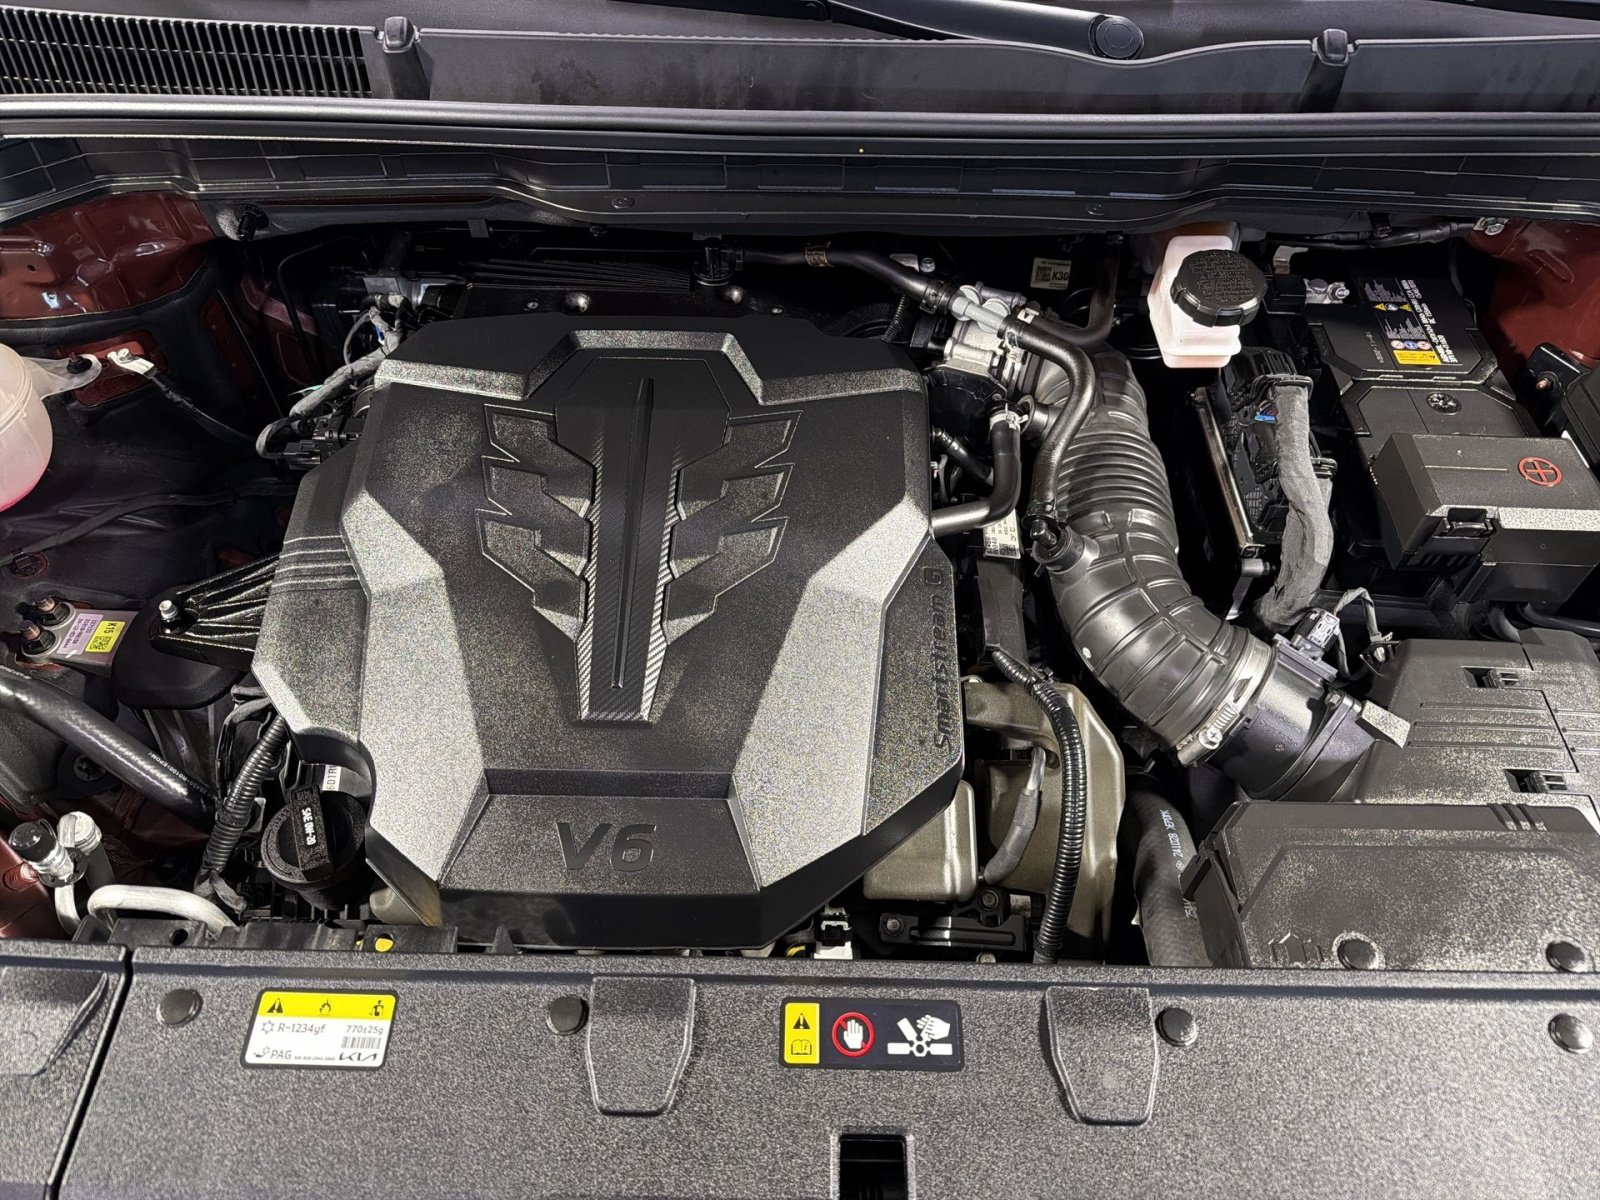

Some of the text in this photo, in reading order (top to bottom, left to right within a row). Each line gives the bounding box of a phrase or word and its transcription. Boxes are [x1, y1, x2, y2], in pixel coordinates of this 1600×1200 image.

[104, 622, 118, 634] K15
[931, 593, 951, 749] Smartstream
[302, 807, 317, 846] SAE 0W-20
[556, 822, 657, 872] V6
[1168, 832, 1184, 859] 241028
[277, 1022, 384, 1035] R-1234yf 770±25g
[270, 1049, 292, 1060] PAG
[339, 1052, 378, 1062] KIA
